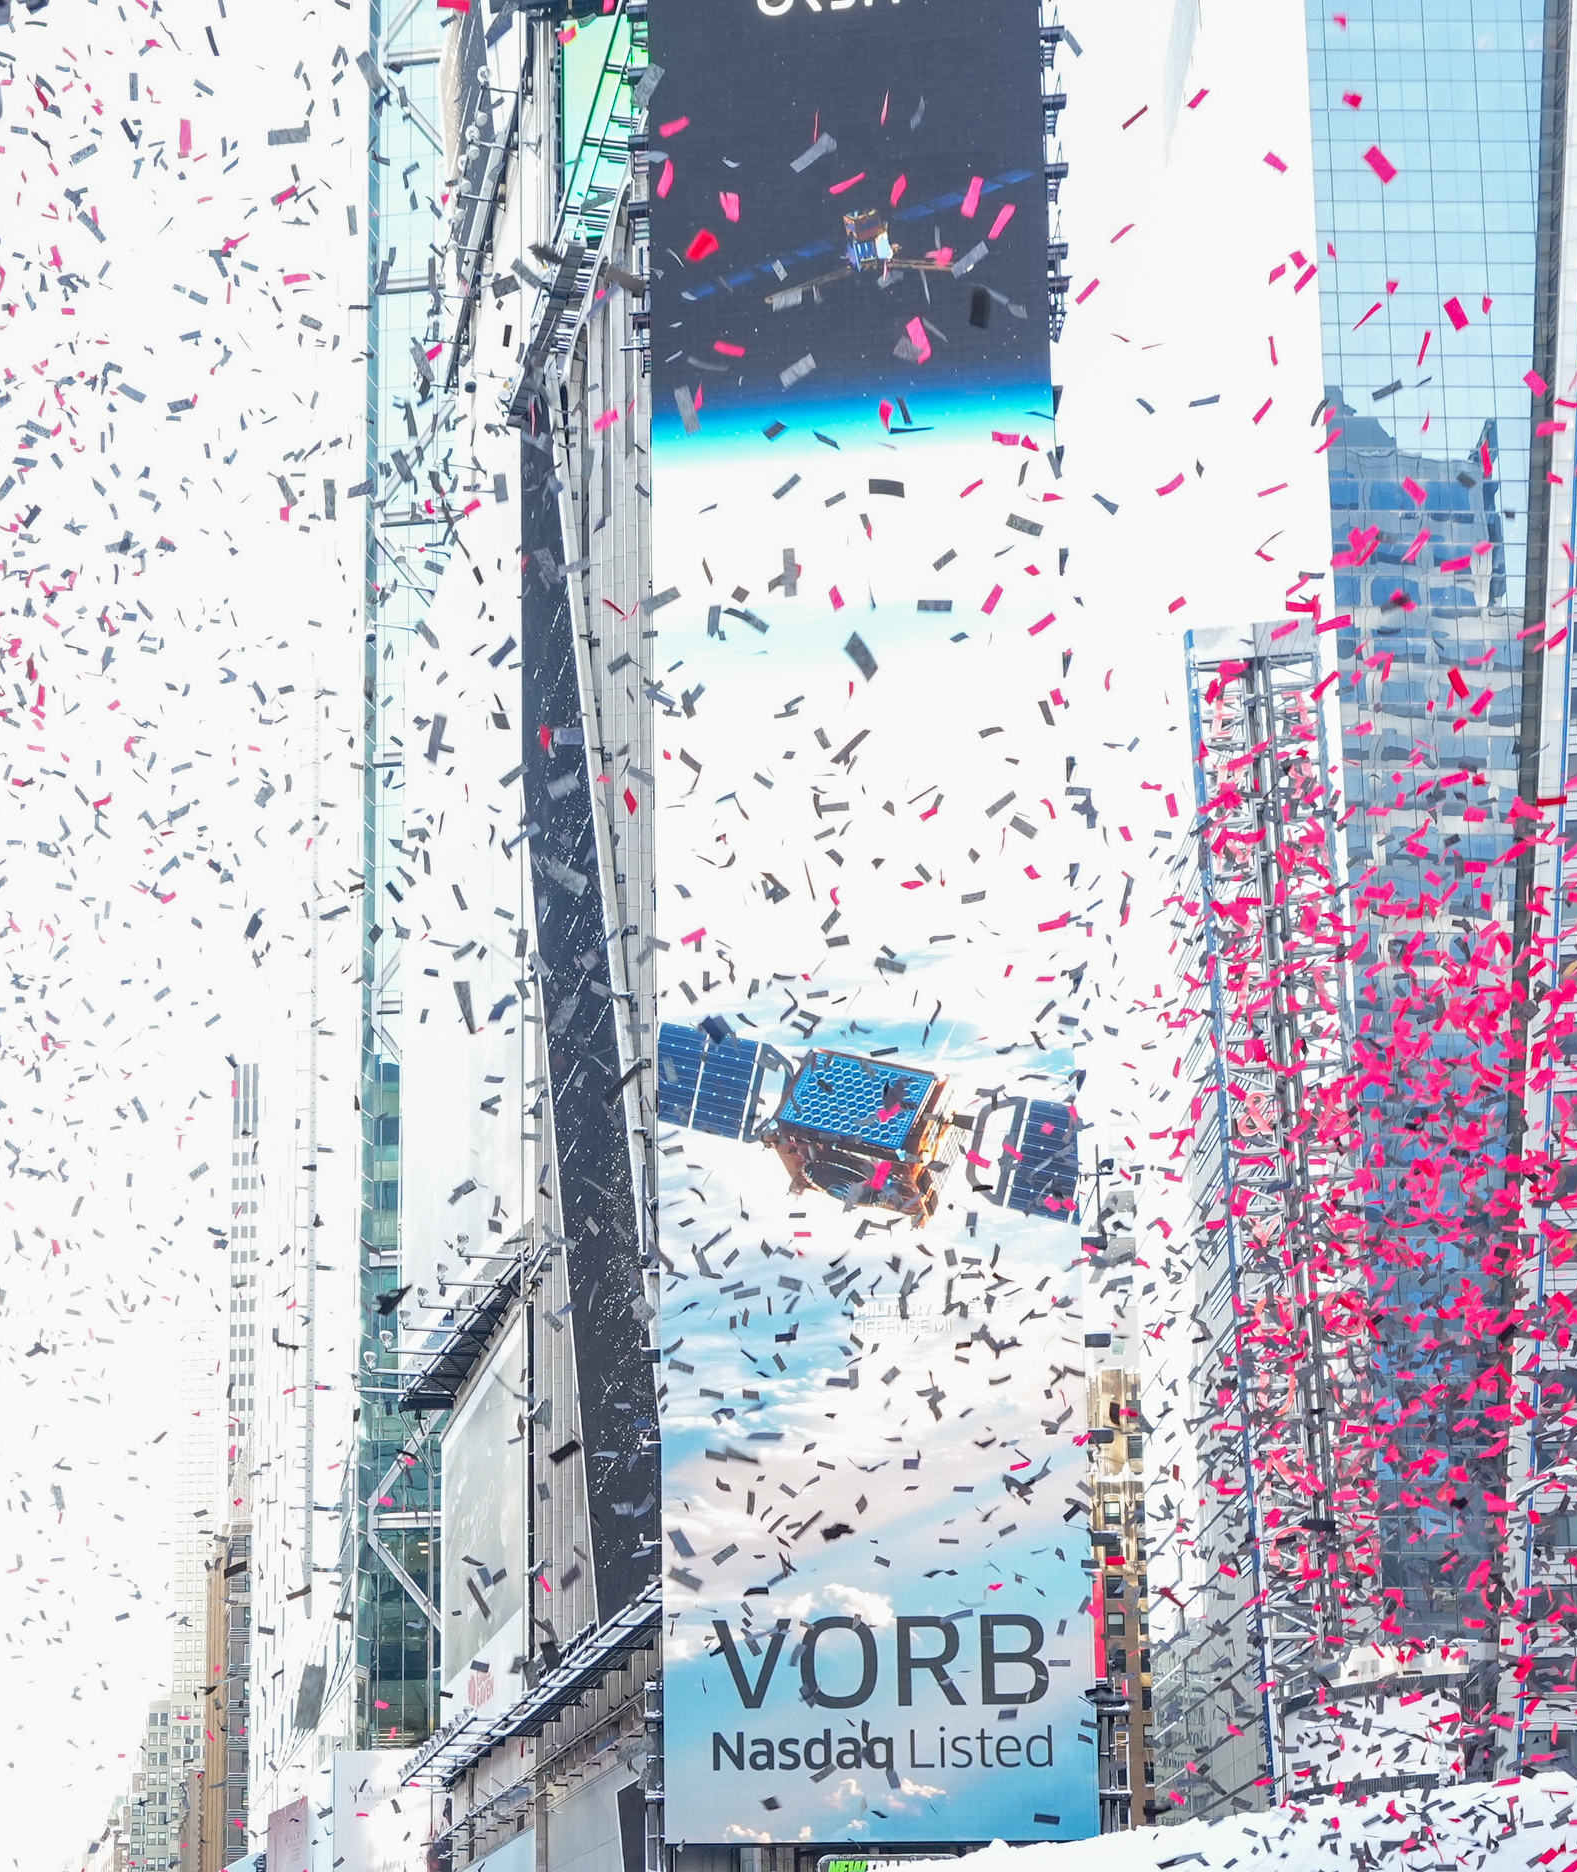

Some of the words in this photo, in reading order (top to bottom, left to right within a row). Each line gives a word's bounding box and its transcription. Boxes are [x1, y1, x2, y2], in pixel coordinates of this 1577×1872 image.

[712, 1614, 1049, 1709] VORB
[712, 1728, 894, 1774] Nasdaq
[910, 1725, 1053, 1768] Listed
